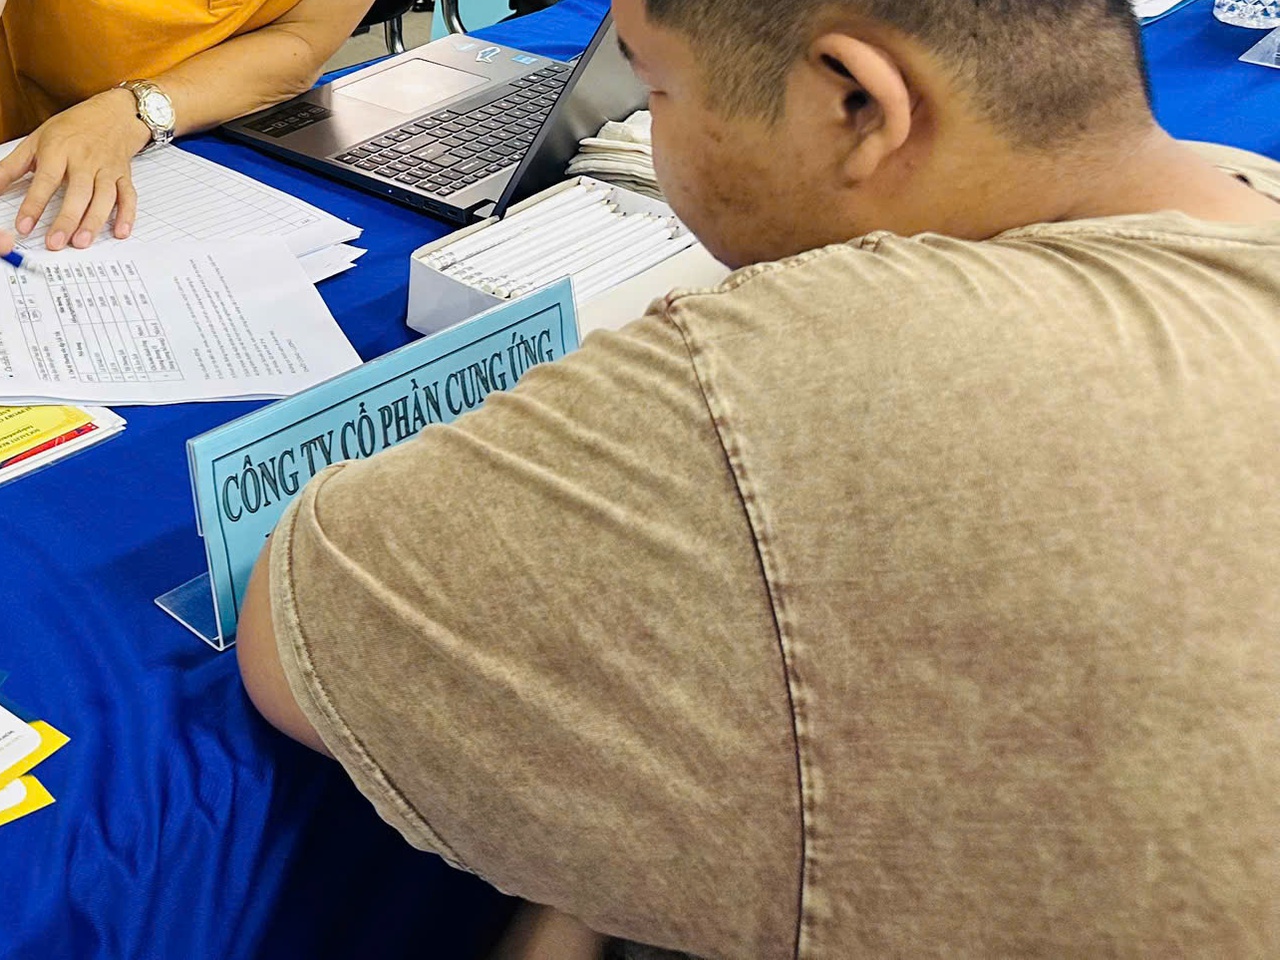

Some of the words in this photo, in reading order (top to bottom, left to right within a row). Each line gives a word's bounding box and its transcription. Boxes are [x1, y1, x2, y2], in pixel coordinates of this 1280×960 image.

[222, 454, 300, 523] CÔNG
[300, 430, 337, 478] TY
[340, 402, 375, 461] CỔ
[377, 377, 443, 449] PHẦN
[448, 349, 507, 416] CUNG
[508, 328, 554, 384] ỨNG
